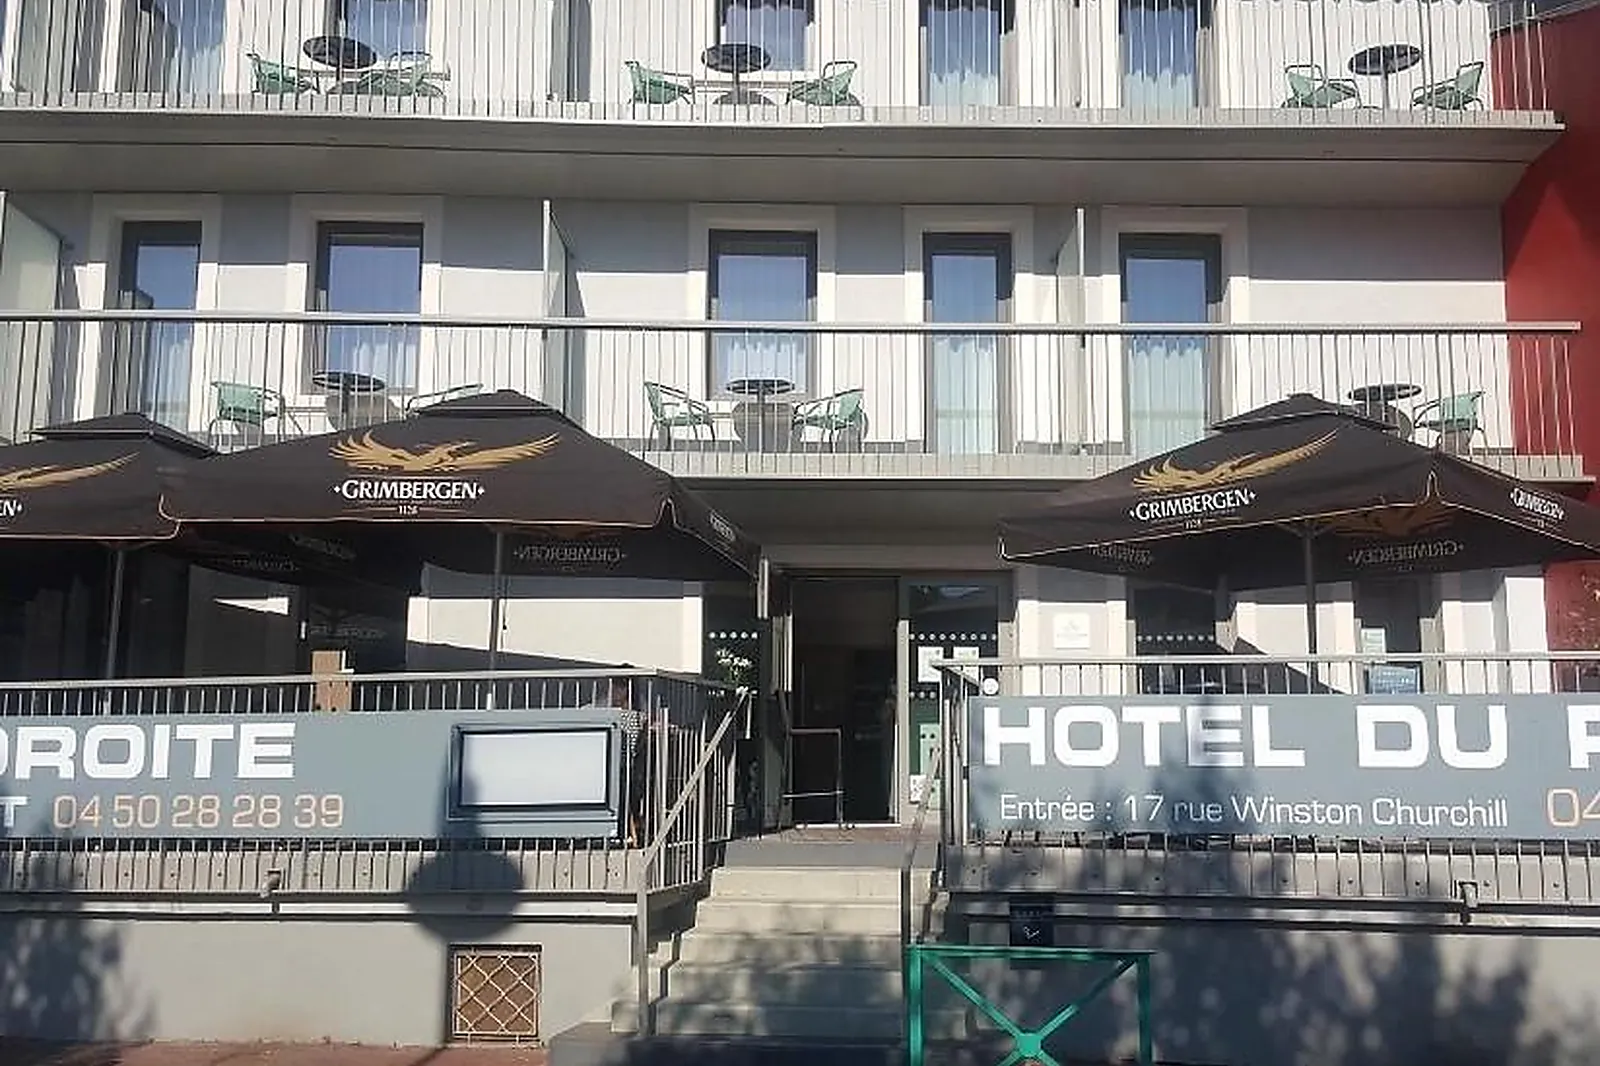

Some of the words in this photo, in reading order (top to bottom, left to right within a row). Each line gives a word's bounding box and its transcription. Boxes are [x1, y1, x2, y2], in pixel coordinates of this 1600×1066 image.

[341, 479, 478, 499] GRIMBERGEN
[1135, 488, 1249, 520] GRIMBERGEN
[0, 722, 296, 780] ROITE
[983, 704, 1306, 767] HOTEL
[1356, 704, 1508, 769] DU
[53, 794, 102, 829] 04
[112, 794, 161, 829] 50
[171, 794, 220, 829] 28
[232, 794, 282, 829] 28
[293, 794, 344, 829] 39
[1000, 790, 1094, 821] Entrée
[1123, 795, 1164, 822] 17
[1174, 801, 1223, 823] rue
[1231, 796, 1362, 824] Winston
[1372, 797, 1508, 827] Churchill
